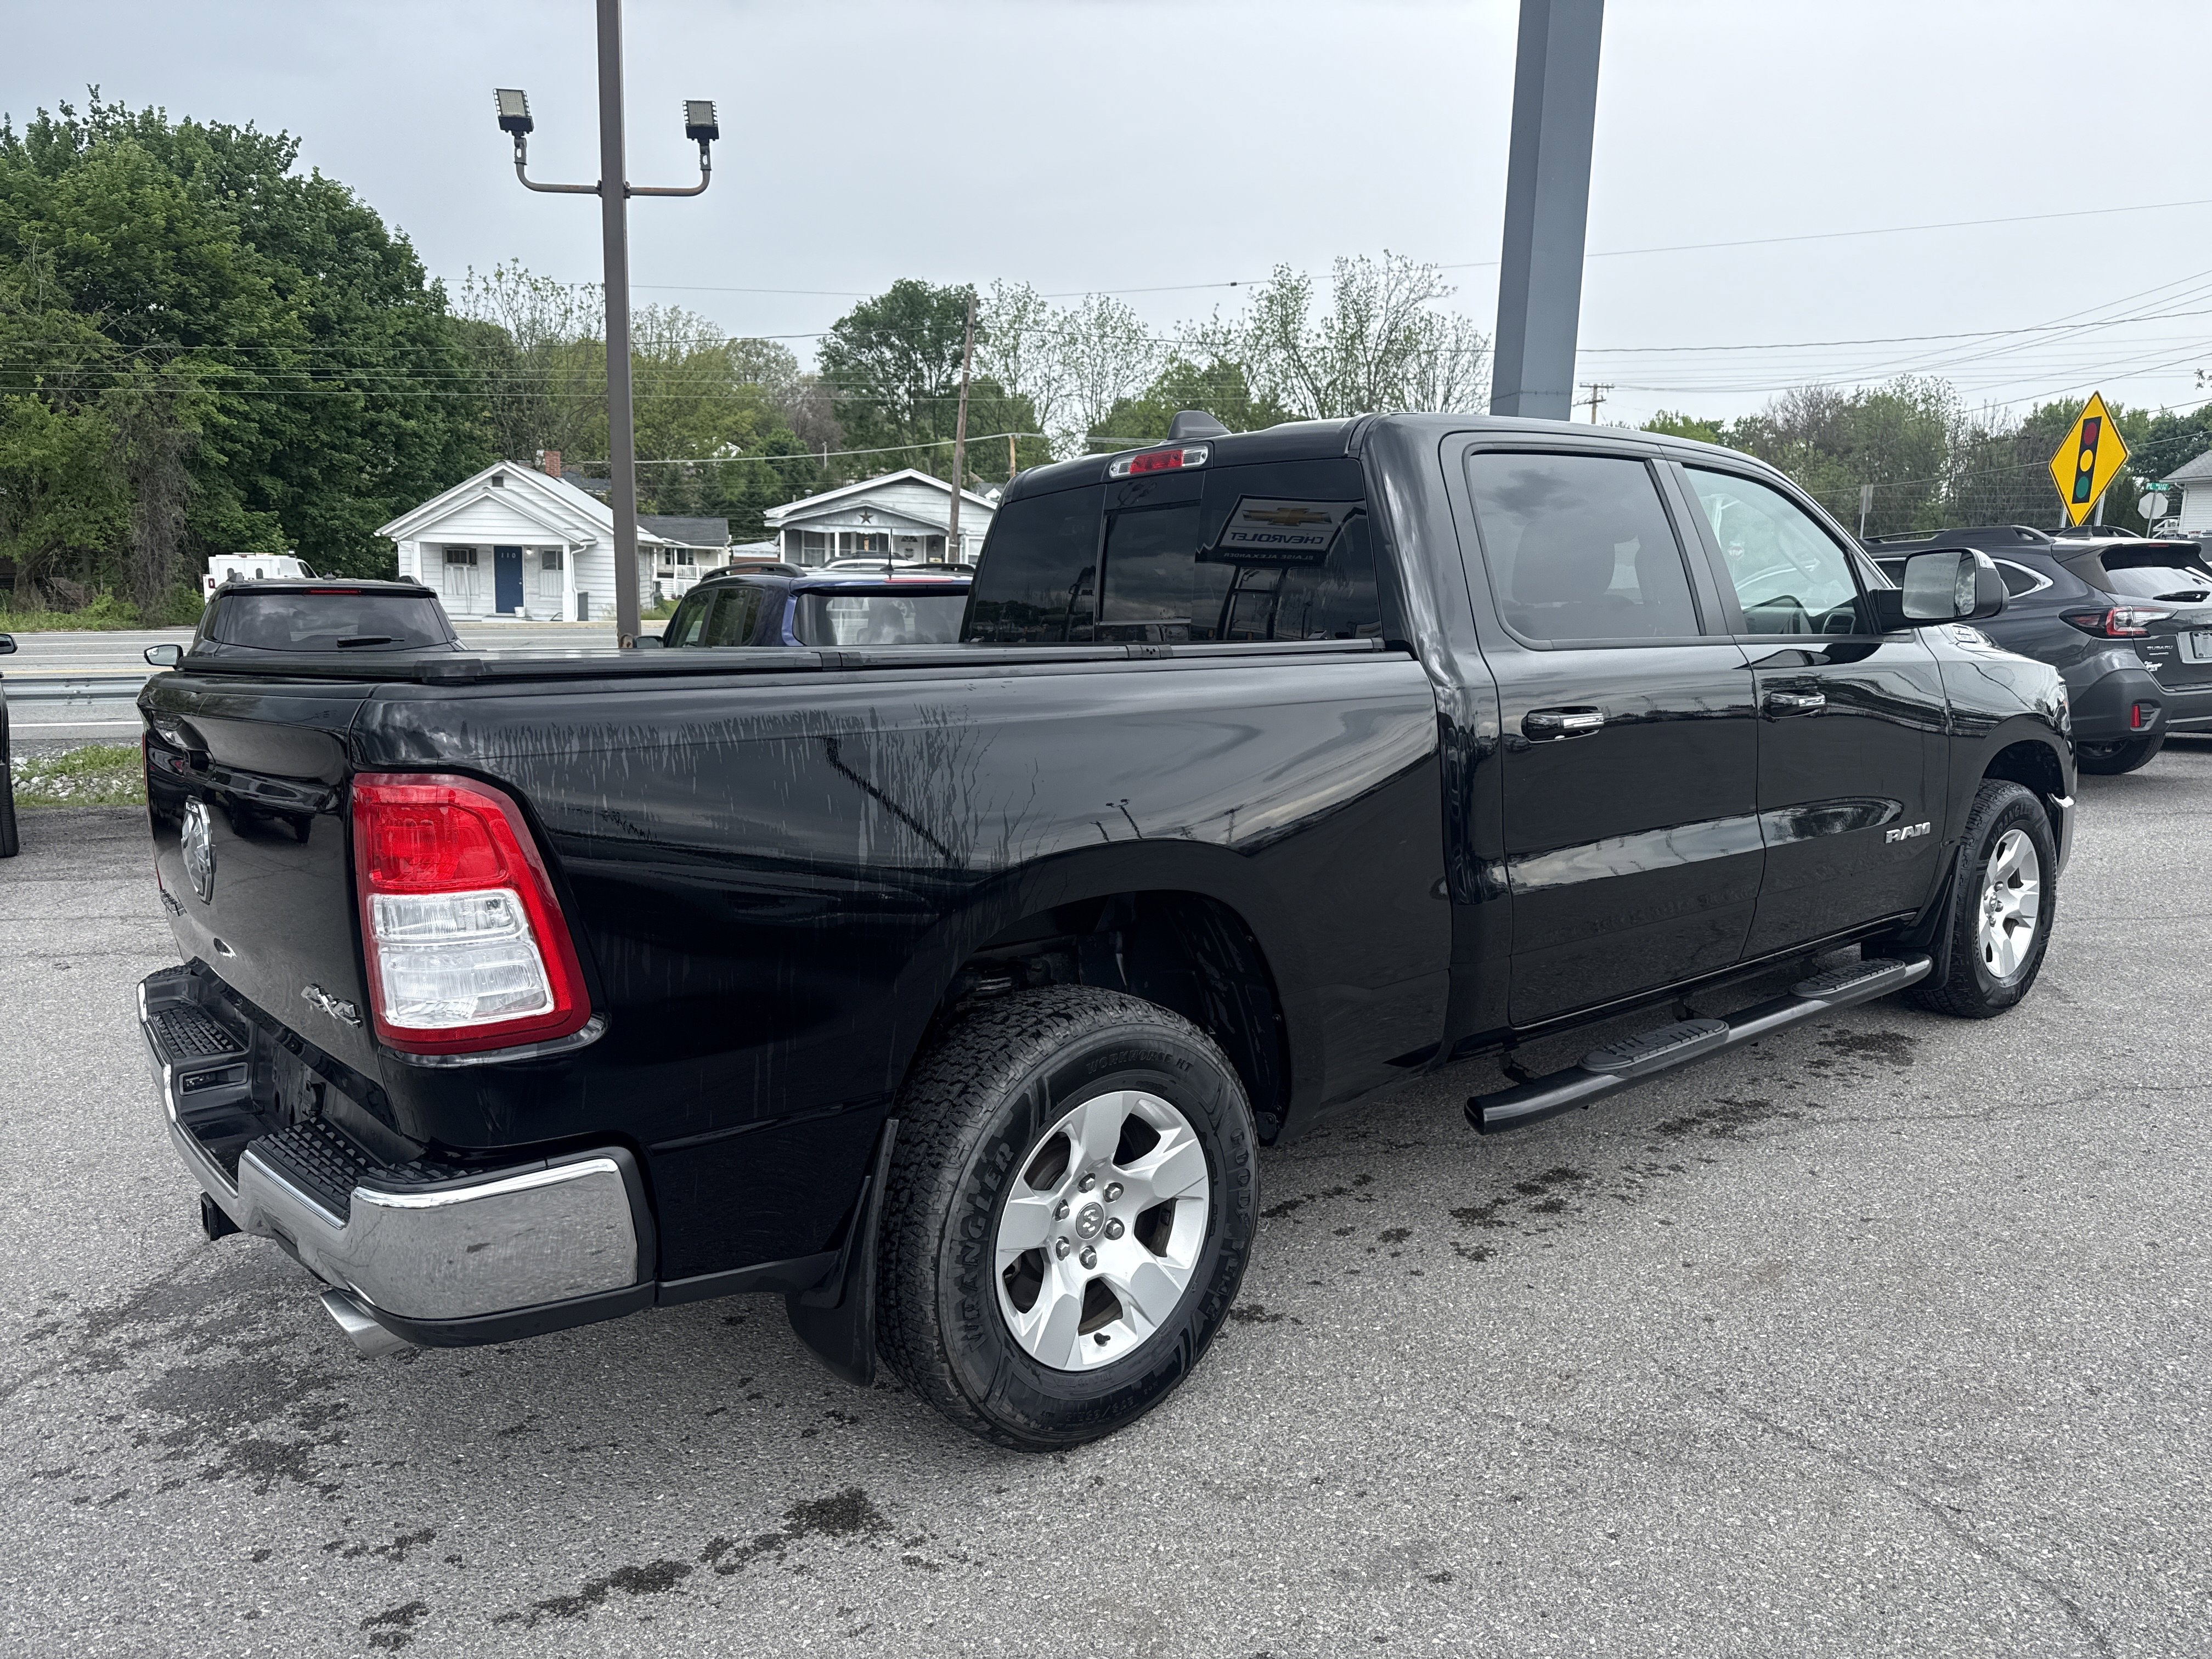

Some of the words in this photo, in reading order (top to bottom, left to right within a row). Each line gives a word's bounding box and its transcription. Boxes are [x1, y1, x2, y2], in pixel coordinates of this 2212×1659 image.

[1885, 821, 1931, 844] RAM
[1086, 1049, 1173, 1075] WORKHORSE
[1175, 1057, 1194, 1072] HT
[961, 1142, 1014, 1353] WRANGLER
[1207, 1128, 1251, 1318] GOODYEAR
